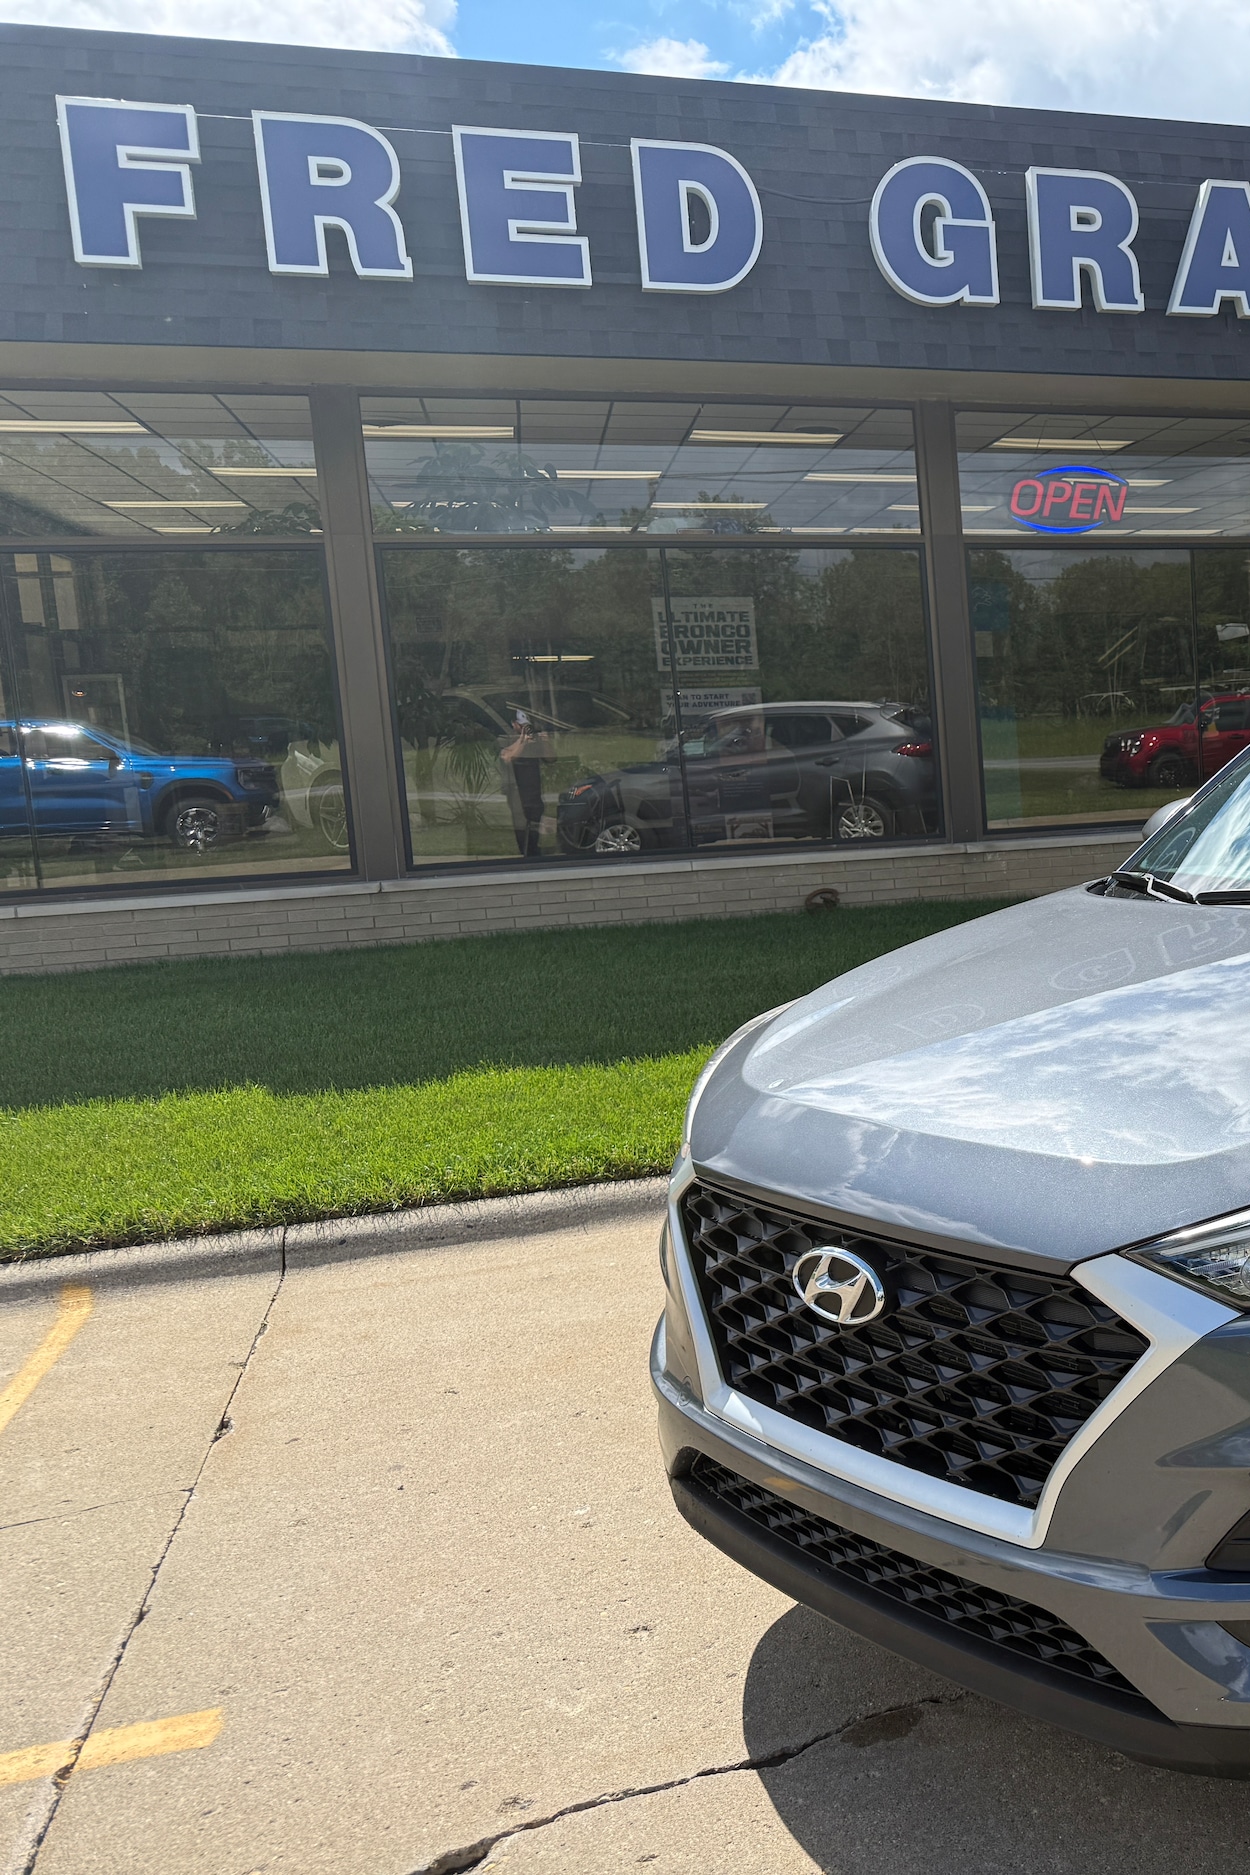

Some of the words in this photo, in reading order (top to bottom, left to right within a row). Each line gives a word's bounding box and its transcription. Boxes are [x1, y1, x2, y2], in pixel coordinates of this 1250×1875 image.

[55, 94, 764, 295] FRED
[1010, 479, 1128, 521] OPEN
[660, 625, 750, 639] BRONCO
[661, 640, 752, 655] OWNER
